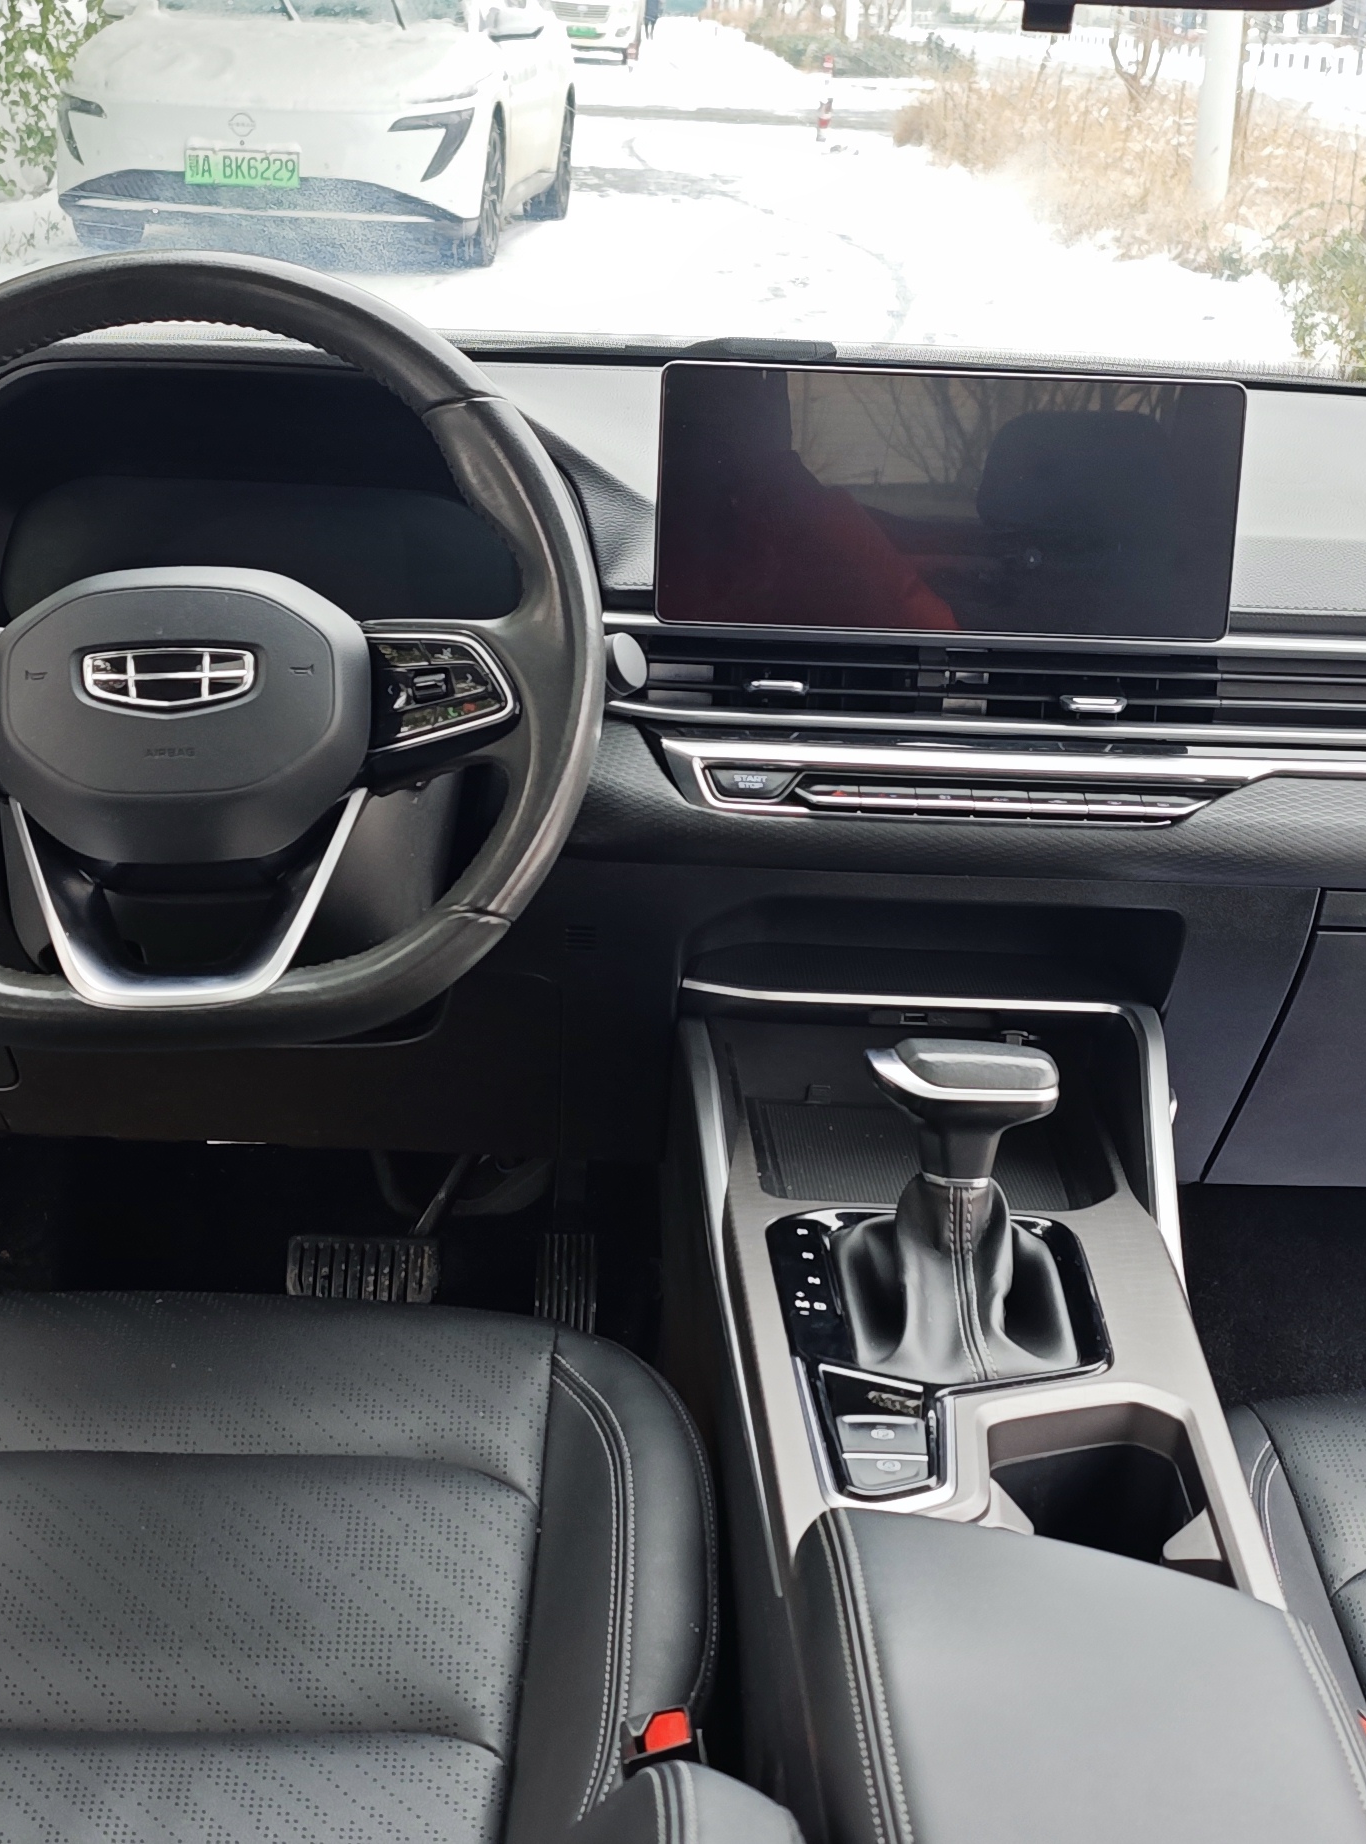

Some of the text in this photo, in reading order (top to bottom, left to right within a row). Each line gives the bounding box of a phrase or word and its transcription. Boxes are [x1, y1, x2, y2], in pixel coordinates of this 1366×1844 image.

[144, 747, 196, 758] AIRBAG
[733, 774, 768, 783] START
[738, 781, 764, 789] STOP
